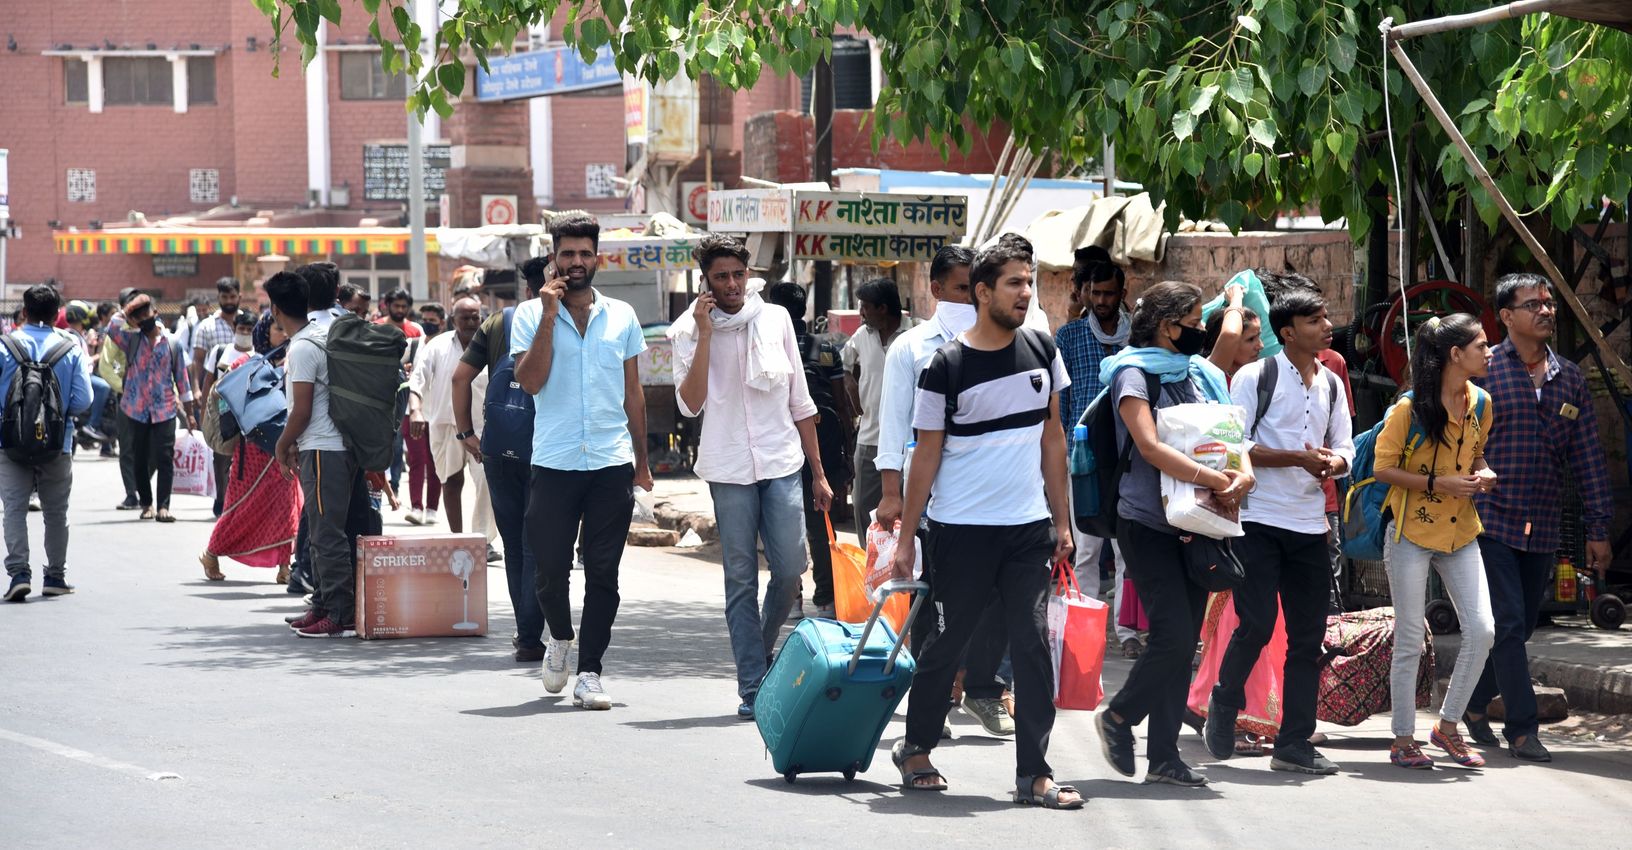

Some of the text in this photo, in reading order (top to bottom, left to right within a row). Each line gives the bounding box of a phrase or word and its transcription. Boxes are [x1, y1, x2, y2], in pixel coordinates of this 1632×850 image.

[836, 198, 900, 226] नाश्ता
[903, 195, 966, 227] कॉर्नर
[628, 244, 662, 269] दूध
[829, 234, 888, 257] नाश्ता
[373, 554, 426, 567] STRIKER
